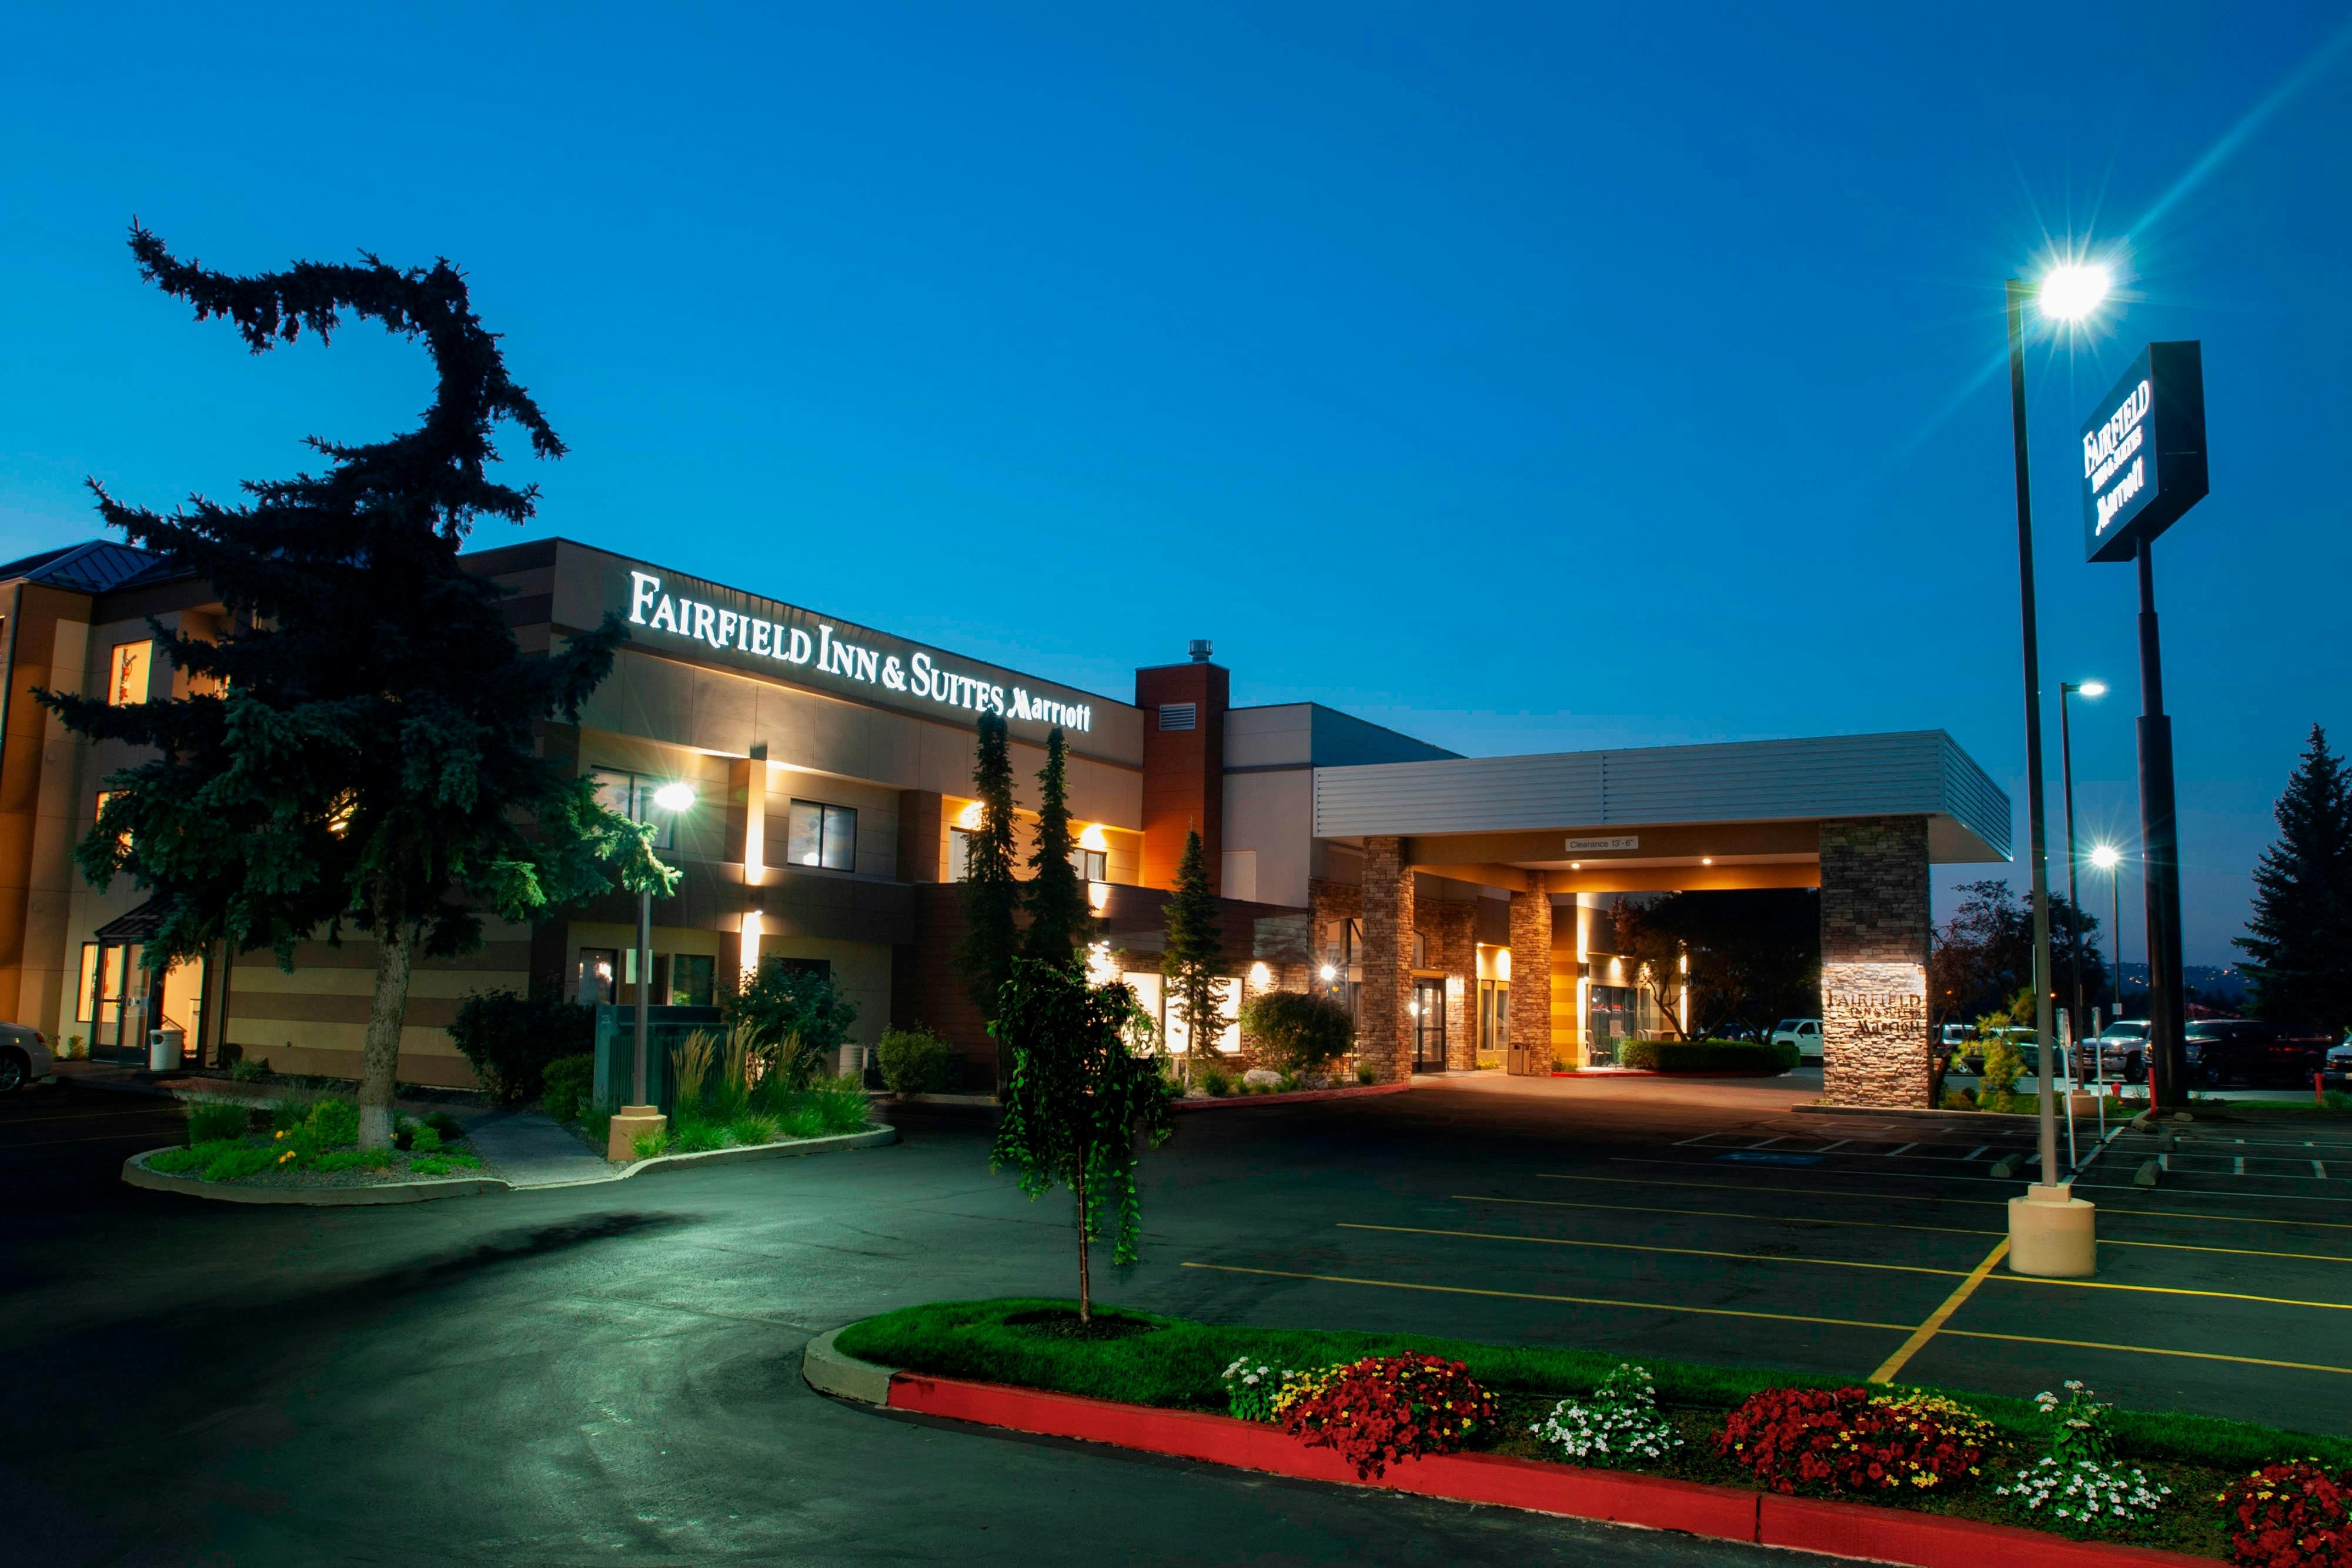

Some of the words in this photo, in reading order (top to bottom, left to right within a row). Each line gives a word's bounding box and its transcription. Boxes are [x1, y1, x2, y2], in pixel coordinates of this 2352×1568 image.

[2083, 380, 2150, 479] FAIRFIELD
[629, 570, 812, 665] FAIRFIELD
[816, 623, 880, 684] INN
[881, 655, 908, 692] &
[910, 651, 1004, 717] SUITES
[1005, 687, 1091, 733] Marriott
[1570, 841, 1609, 849] Clearance
